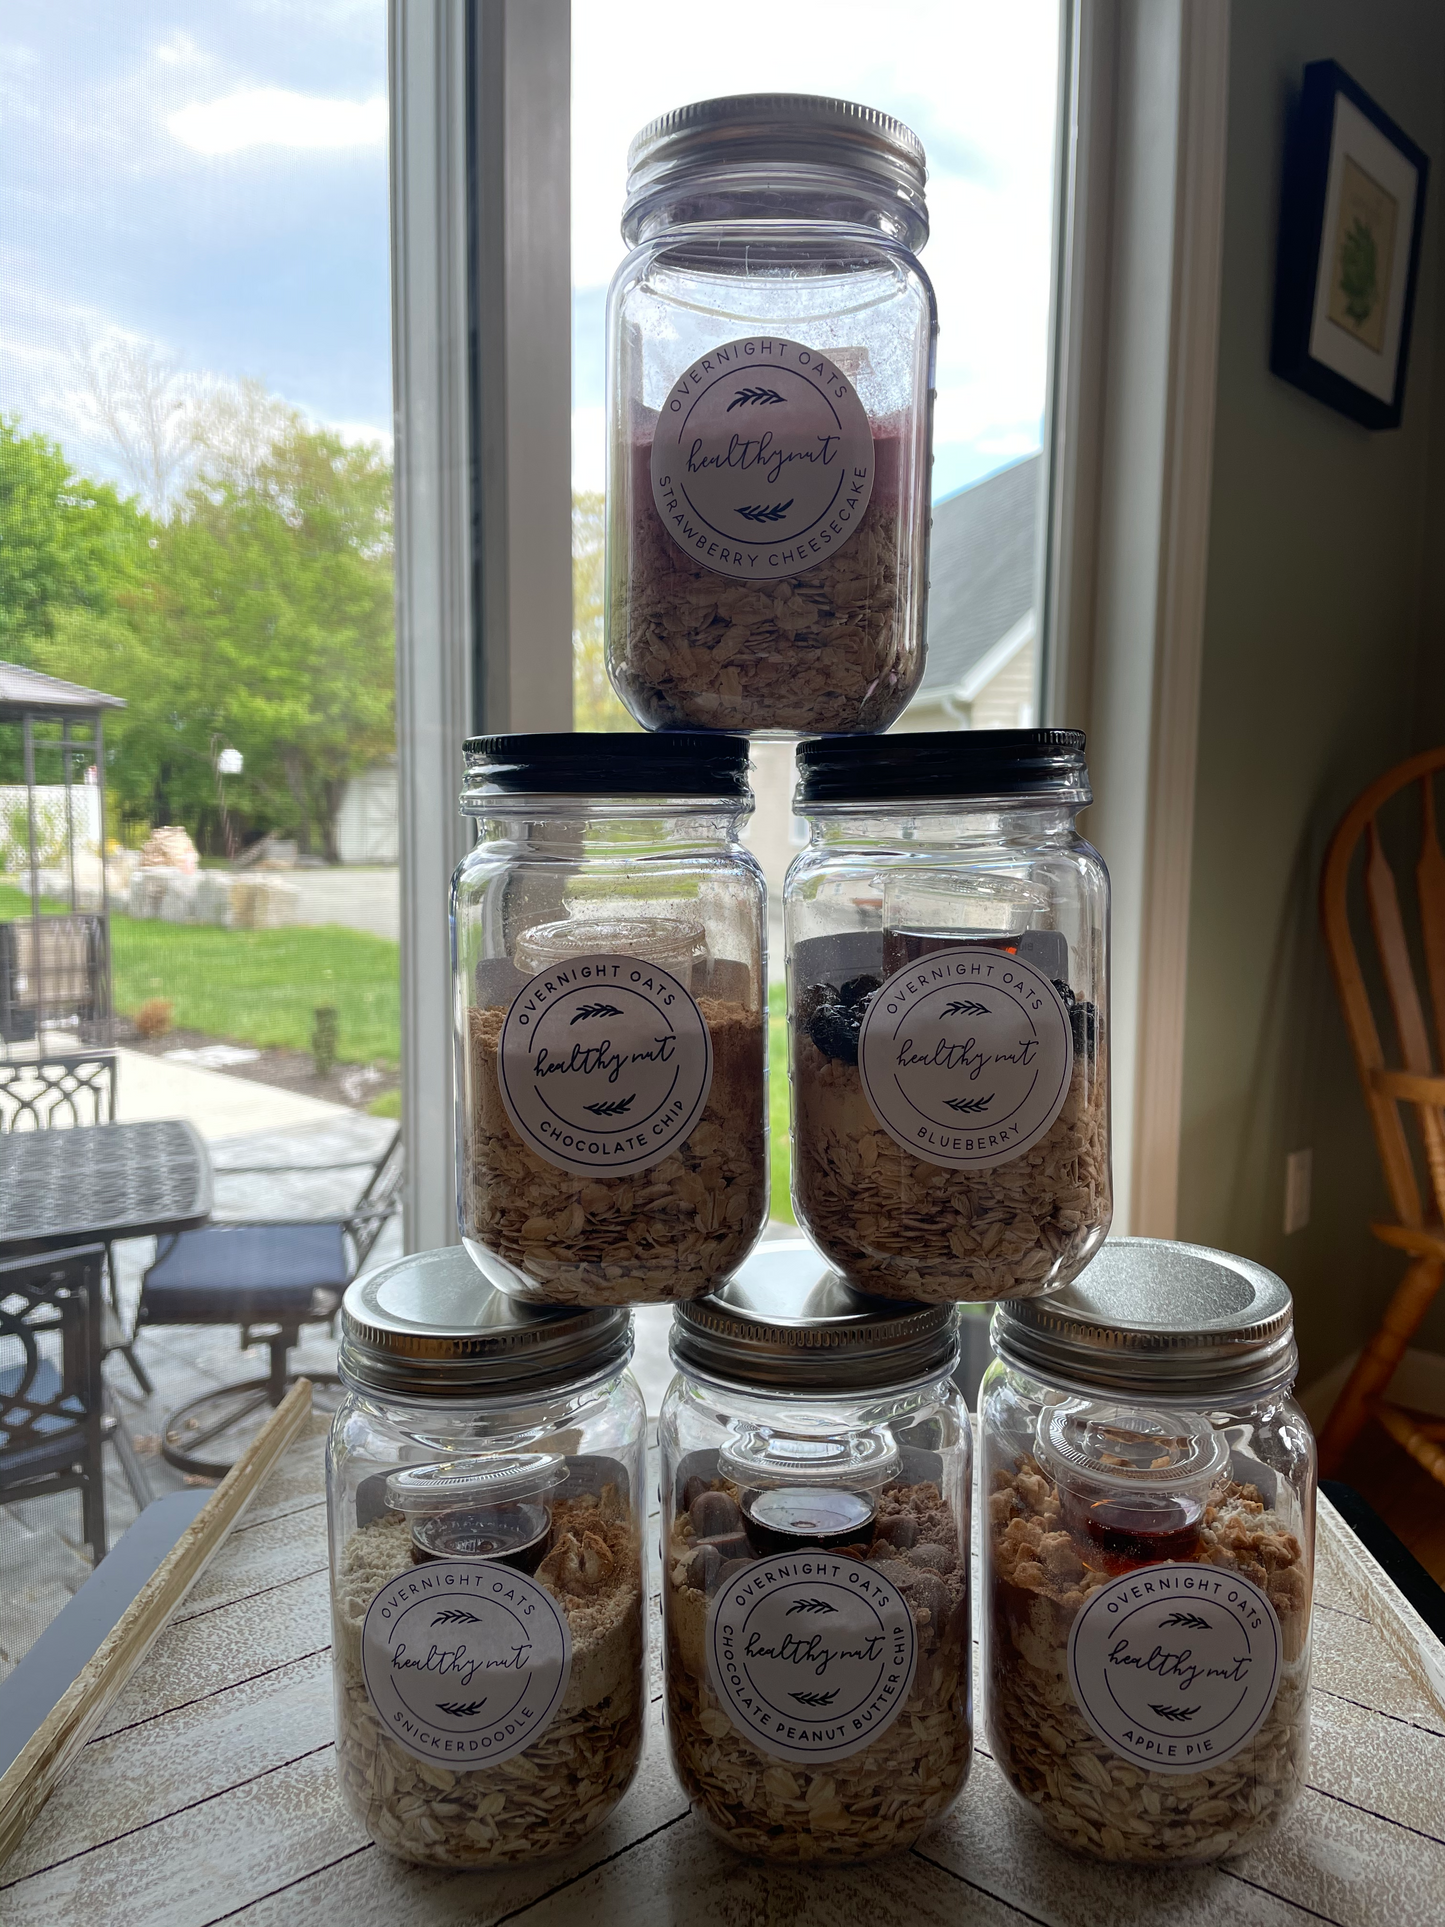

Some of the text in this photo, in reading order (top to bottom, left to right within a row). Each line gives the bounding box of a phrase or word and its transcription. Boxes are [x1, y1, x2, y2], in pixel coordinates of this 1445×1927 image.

[670, 340, 848, 412] OVERNIGHT OATS
[659, 467, 867, 567] STRAWBERRY CHEESECAKE
[519, 965, 676, 1025] OVERNIGHT OATS
[886, 963, 1043, 1014] OVERNIGHT OATS
[540, 1099, 684, 1155] CHOCOLATE CHIP
[917, 1122, 1020, 1150] BLUEBERRY
[381, 1574, 536, 1619] OVERNIGHT OATS
[735, 1563, 890, 1608] OVERNIGHT OATS
[1107, 1577, 1262, 1629] OVERNIGHT OATS
[722, 1625, 905, 1742] CHOCOLATE PEANUT BUTTER CHIP
[393, 1706, 534, 1752] SNICKERDOODLE
[1122, 1730, 1214, 1756] APPLE PIE
